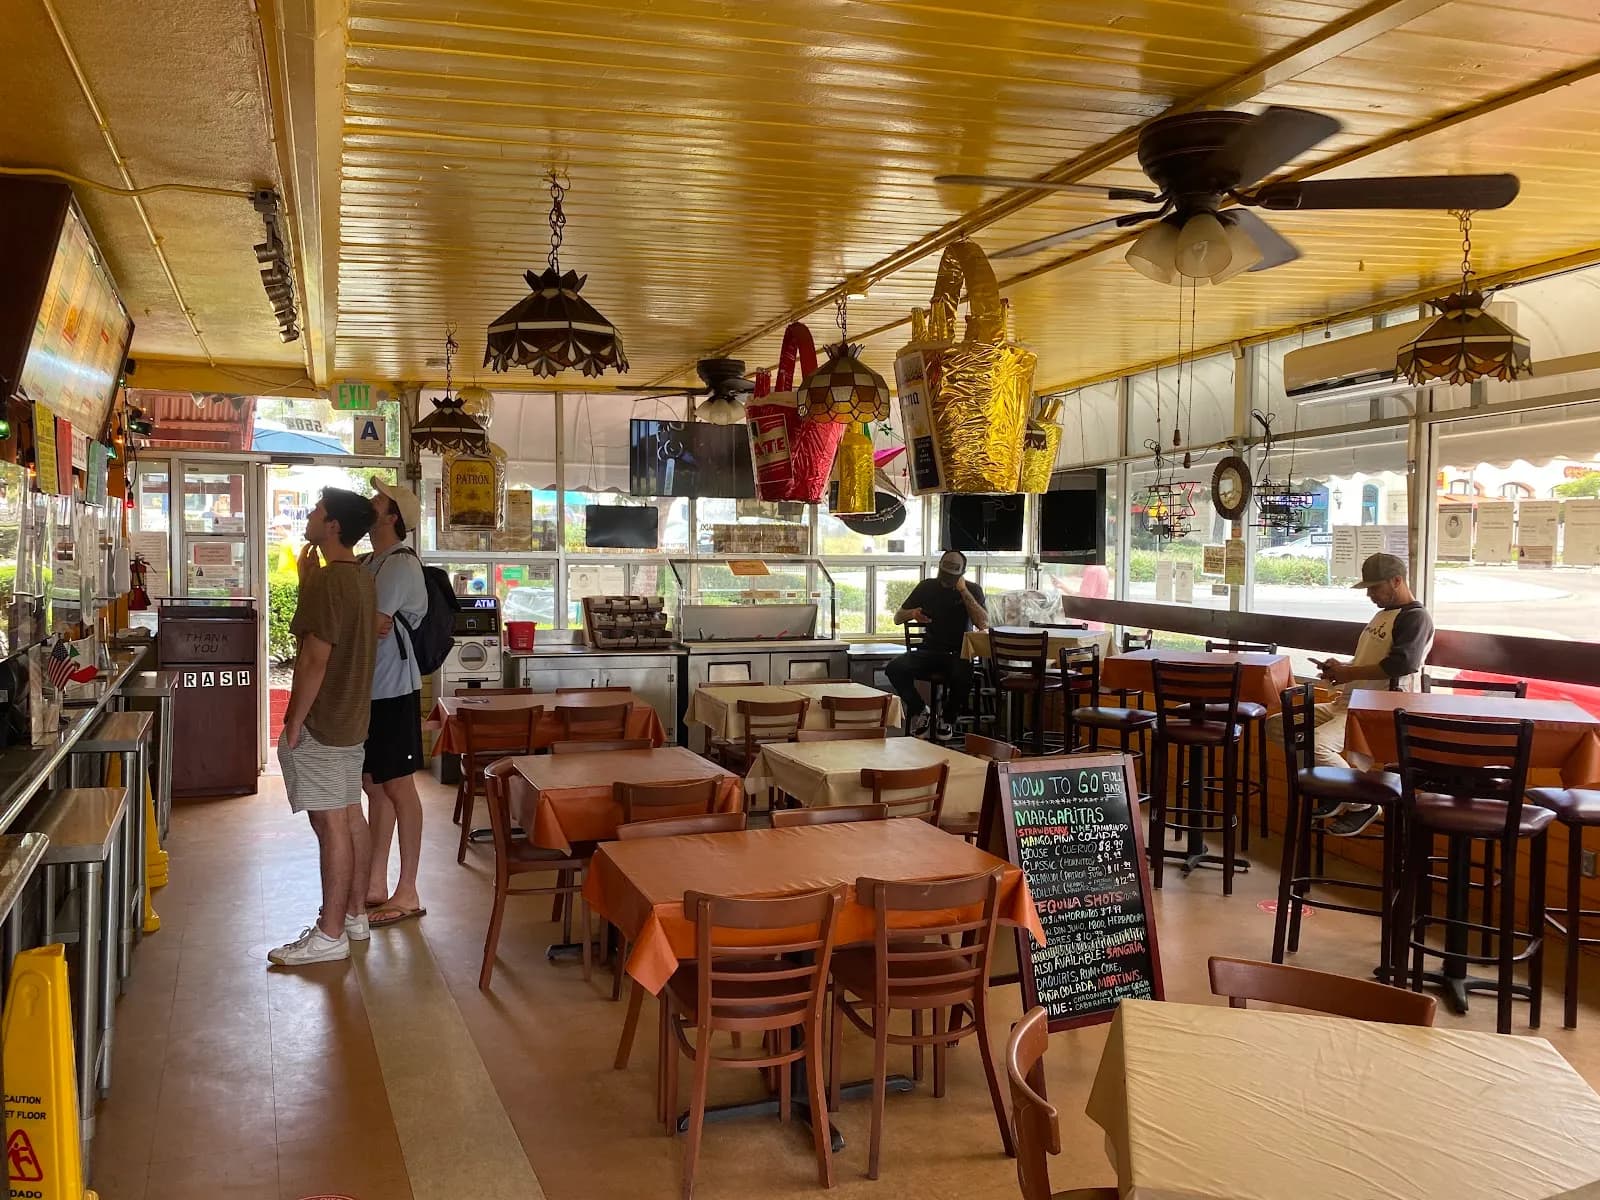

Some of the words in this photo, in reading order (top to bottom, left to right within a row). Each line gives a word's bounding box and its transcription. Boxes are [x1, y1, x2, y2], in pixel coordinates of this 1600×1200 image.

[338, 384, 371, 409] EXIT
[360, 420, 379, 440] A
[754, 437, 785, 457] ATE
[474, 599, 495, 608] ATM
[185, 633, 228, 643] THANK
[193, 644, 218, 653] YOU
[184, 671, 249, 688] RASH
[1012, 776, 1044, 797] NOW
[1048, 776, 1071, 795] TO
[1078, 770, 1099, 793] GO
[1102, 771, 1122, 782] FULL
[1103, 783, 1121, 794] BAR
[1020, 835, 1052, 848] MANGO,
[1020, 848, 1049, 860] HOUSE
[1098, 840, 1124, 852] $8.99
[1022, 860, 1058, 874] CLASSIC
[1031, 885, 1062, 899] ADILLAC
[1034, 896, 1081, 914] TEQUILA
[1084, 891, 1123, 907] SHOTS
[1031, 935, 1071, 950] CADORES
[1034, 962, 1053, 976] ALSO
[17, 1111, 46, 1120] FLOOR
[10, 1190, 42, 1198] DADO
